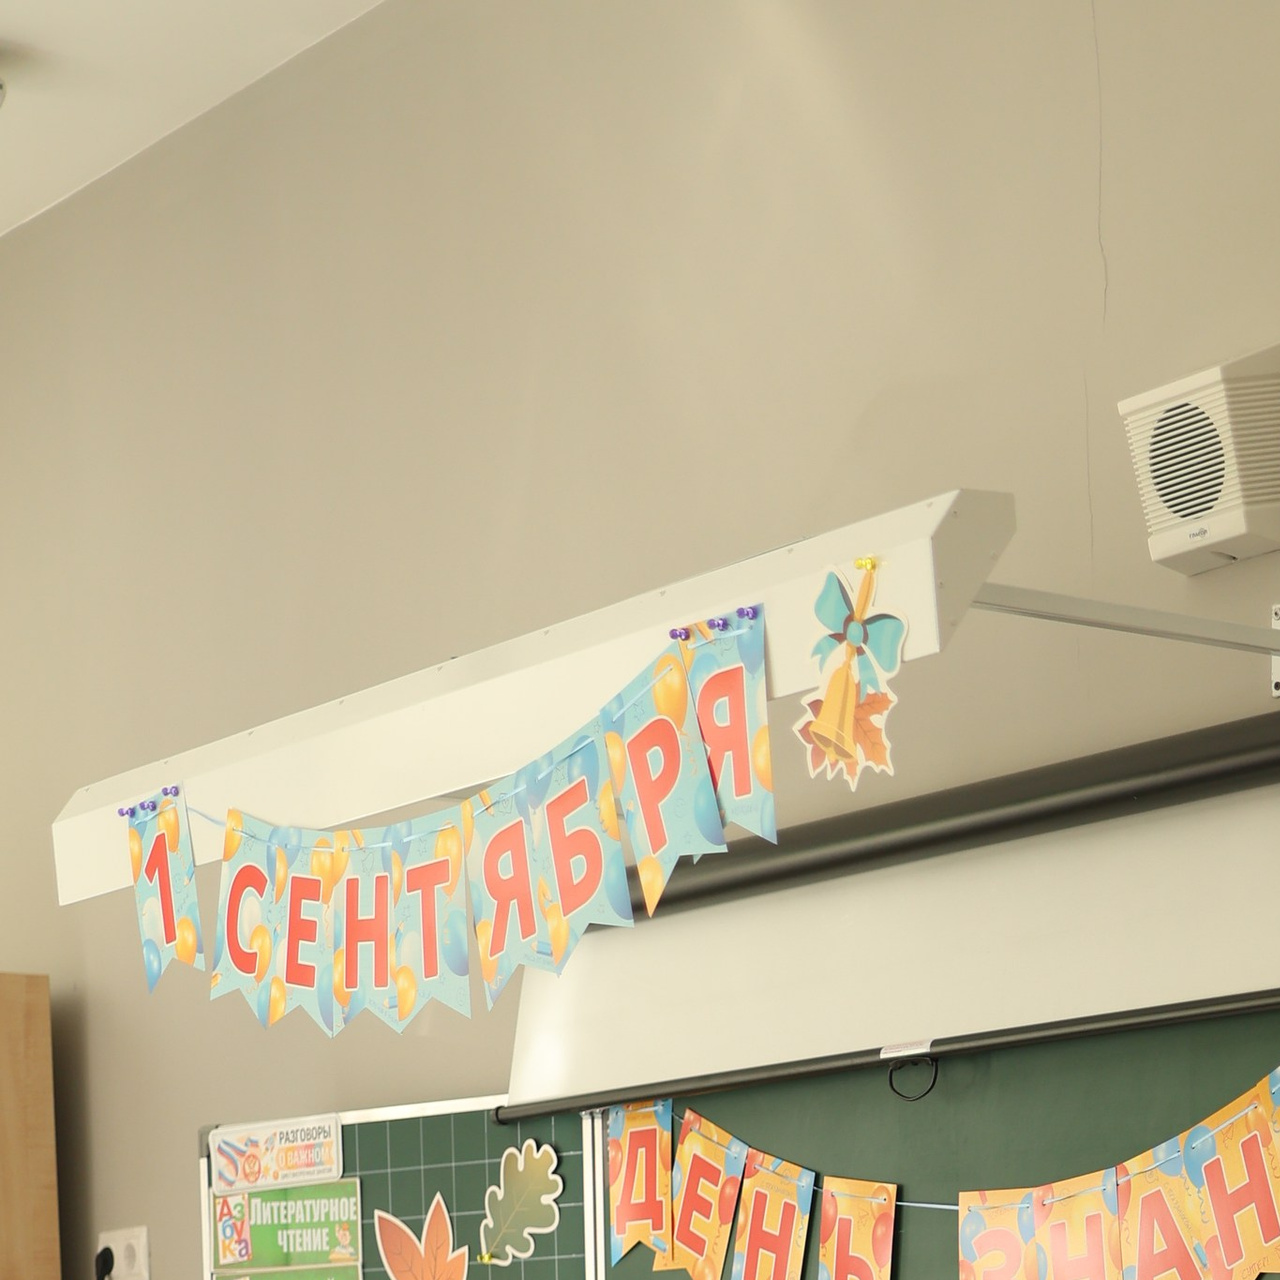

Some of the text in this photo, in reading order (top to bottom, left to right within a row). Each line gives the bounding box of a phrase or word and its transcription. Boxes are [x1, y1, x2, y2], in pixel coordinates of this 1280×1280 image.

[142, 664, 755, 991] 1 СЕНТЯБРЯ
[279, 1124, 332, 1145] РАЗГОВОРЫ
[278, 1227, 330, 1253] ЧТЕНИЕ
